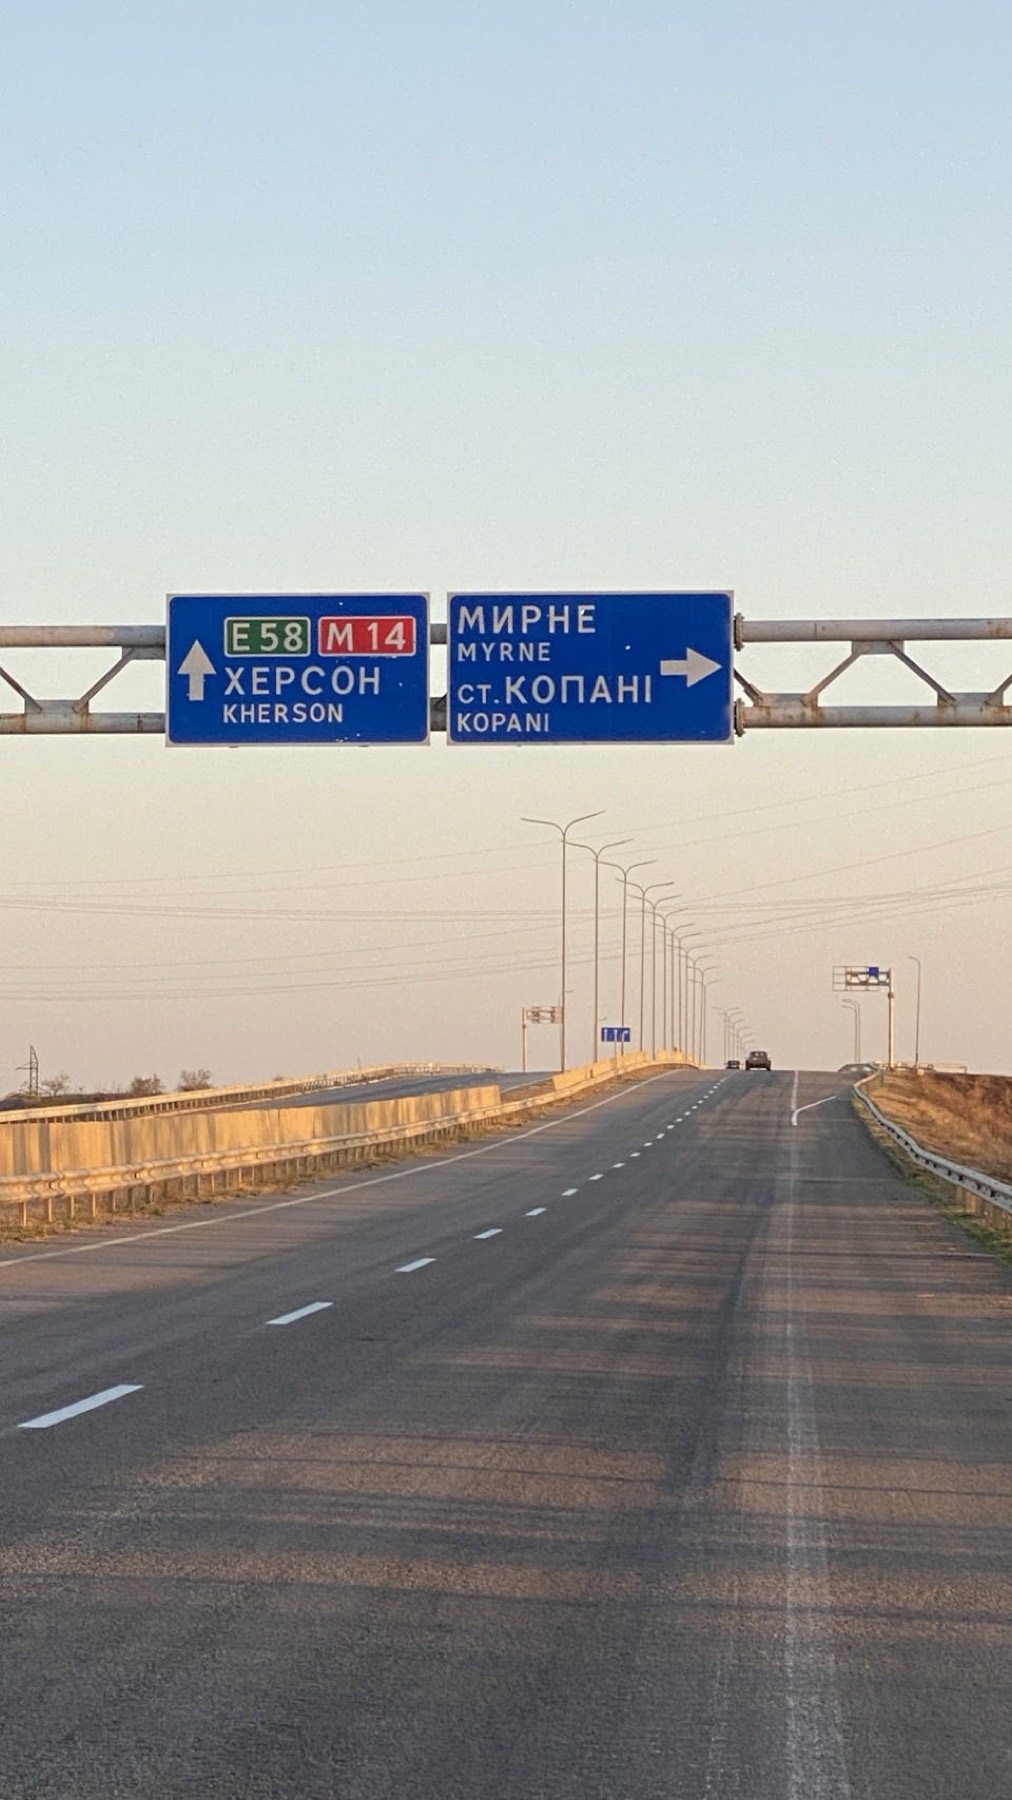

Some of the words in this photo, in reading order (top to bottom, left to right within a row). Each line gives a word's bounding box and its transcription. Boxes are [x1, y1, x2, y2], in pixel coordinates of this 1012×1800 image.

[457, 604, 596, 634] МИРНЕ
[232, 623, 250, 651] E
[260, 622, 303, 651] 58
[326, 622, 353, 651] M
[367, 621, 406, 651] 14
[457, 642, 551, 662] MYRNE
[224, 665, 380, 695] ХЕРСОН
[223, 703, 343, 723] KHERSON
[457, 712, 550, 732] KOPANI
